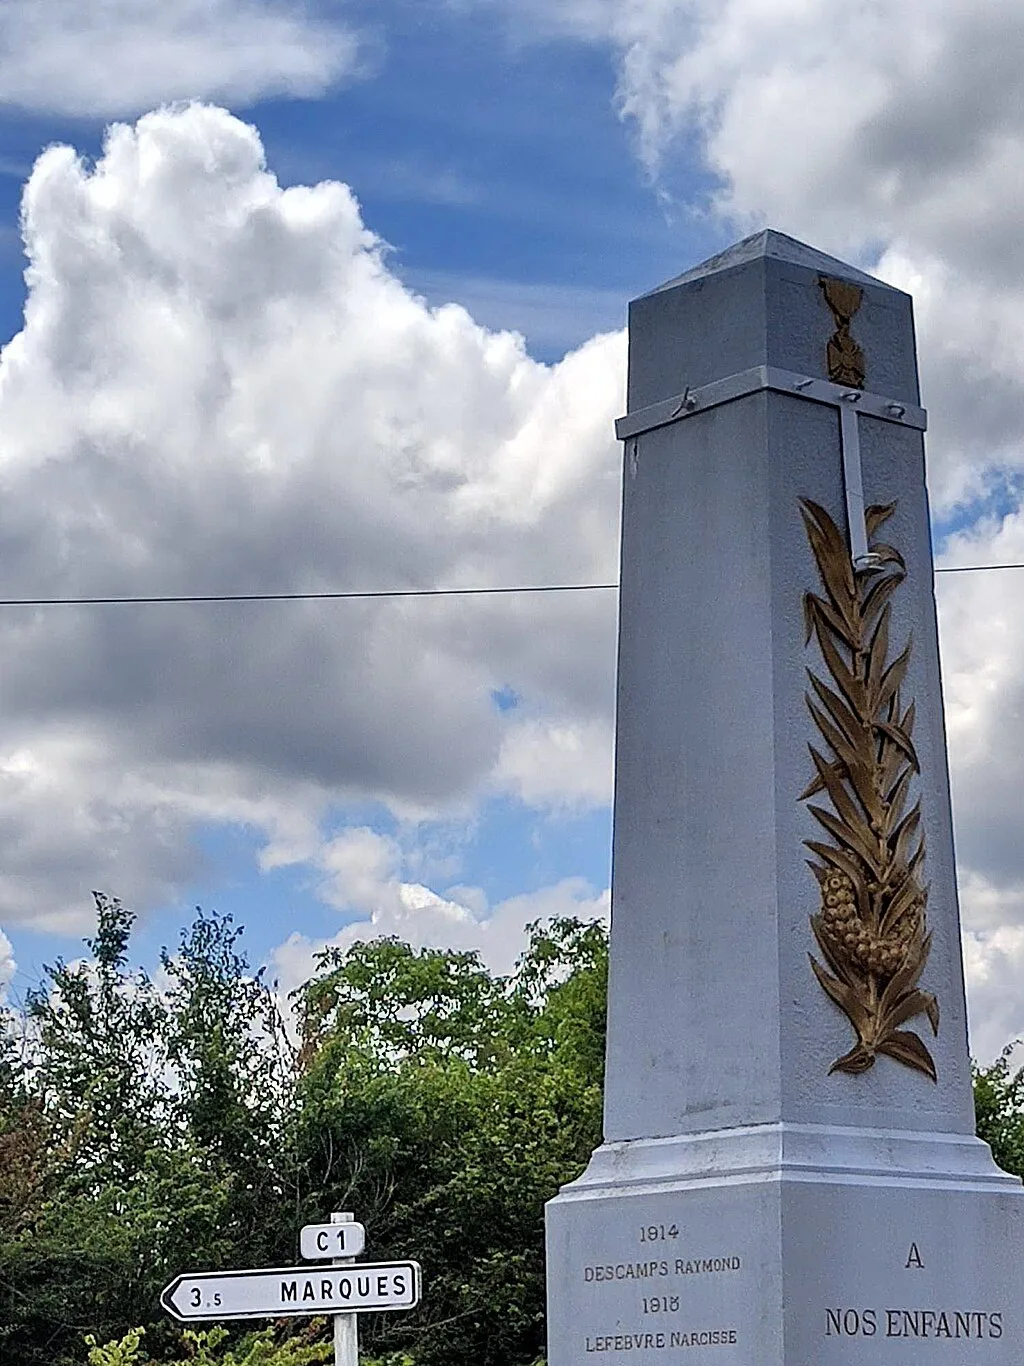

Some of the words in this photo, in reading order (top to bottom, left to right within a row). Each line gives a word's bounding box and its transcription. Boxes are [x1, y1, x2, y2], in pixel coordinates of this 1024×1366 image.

[317, 1231, 329, 1251] C
[336, 1230, 345, 1250] 1
[640, 1225, 679, 1242] 1914
[905, 1242, 925, 1268] A
[584, 1261, 668, 1282] DESCAMPS
[675, 1257, 740, 1275] RAYMOND
[281, 1275, 406, 1302] MARQUES
[825, 1308, 877, 1336] NOS
[885, 1310, 1003, 1338] ENFANTS
[586, 1333, 665, 1352] LEFEBVRE
[671, 1330, 737, 1347] NARCISSE
